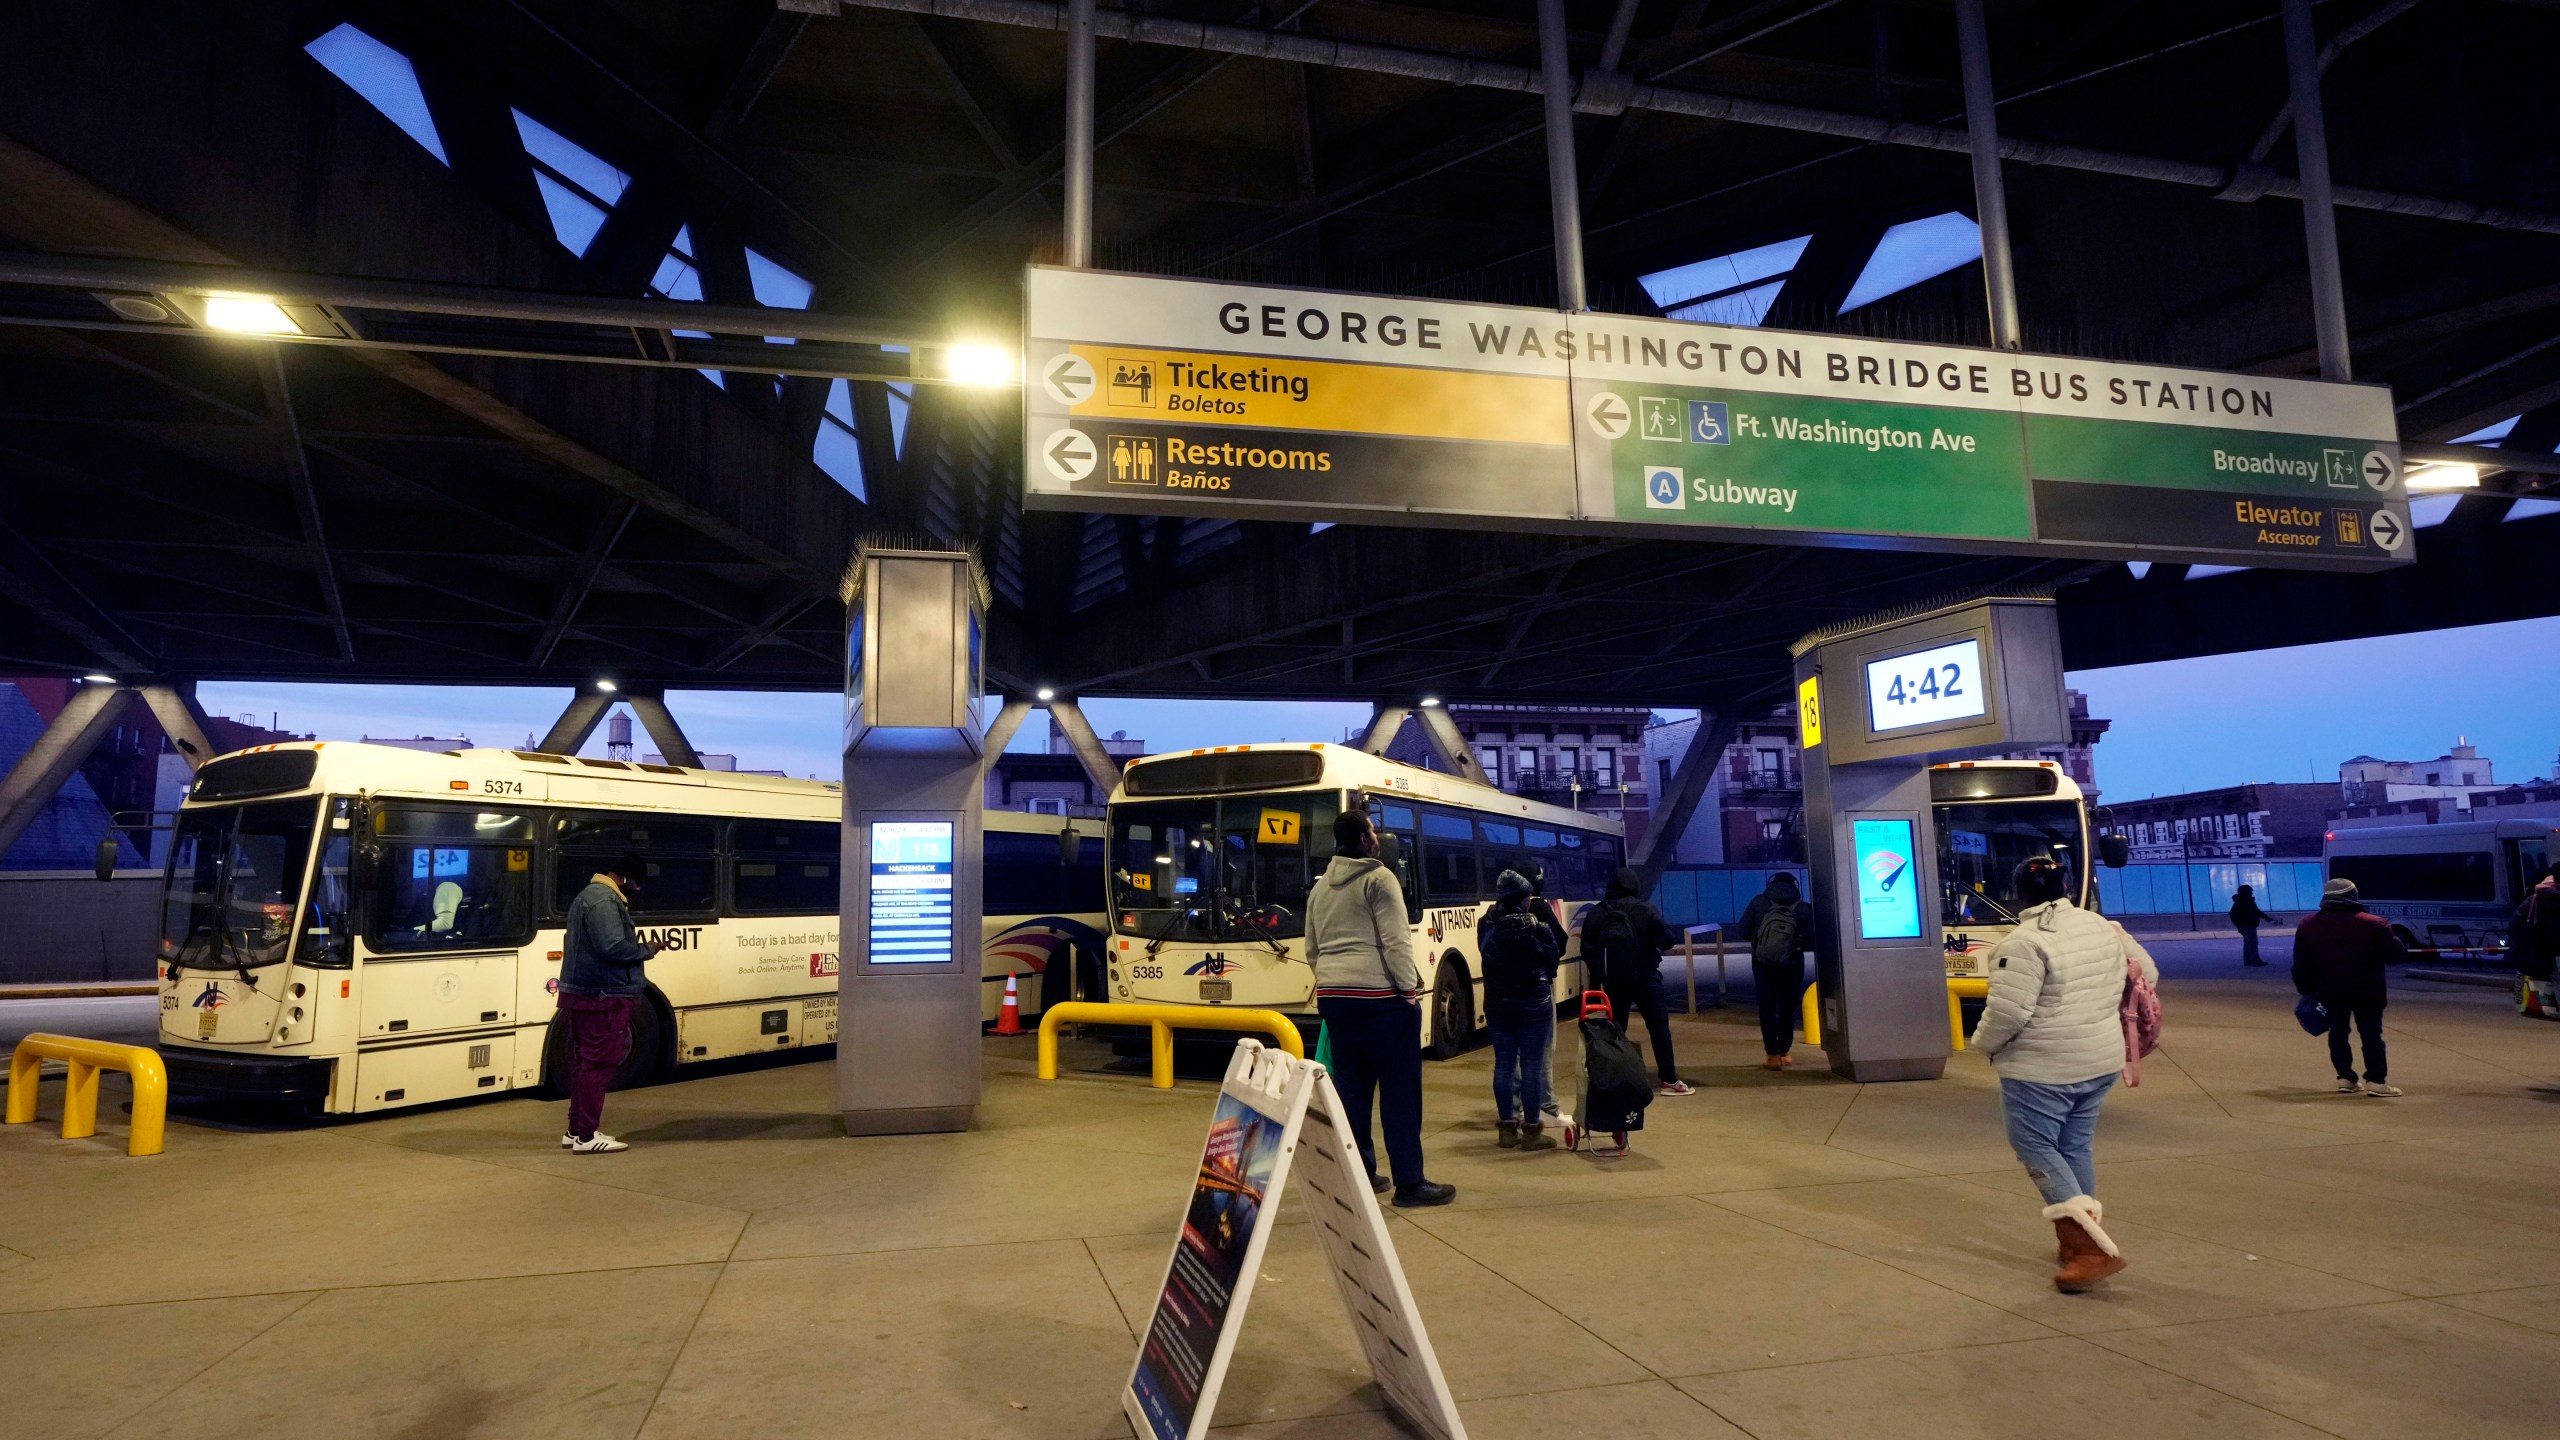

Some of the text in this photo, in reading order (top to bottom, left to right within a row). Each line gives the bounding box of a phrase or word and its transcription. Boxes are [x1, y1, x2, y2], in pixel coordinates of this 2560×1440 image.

[1218, 302, 2273, 418] GEORGE WASHINGTON BRIDGE BUS STATION
[1166, 361, 1309, 402] Ticketing
[1167, 394, 1246, 415] Boletos
[1736, 413, 1975, 452] Ft. Washington Ave
[1167, 437, 1331, 472] Restrooms
[2213, 449, 2319, 483] Broadway
[1166, 470, 1231, 490] Baños
[1657, 479, 1673, 498] A
[1692, 478, 1798, 513] Subway
[2235, 501, 2321, 527] Elevator
[2258, 529, 2320, 546] Ascensor
[1886, 663, 1963, 705] 4:42
[1803, 696, 1817, 730] 18
[484, 780, 523, 794] 5374
[2369, 906, 2442, 917] EXPRESS SERVICE
[1431, 908, 1475, 943] NJ TRANSIT
[636, 928, 702, 951] ANSIT
[736, 935, 767, 949] Today
[770, 934, 778, 946] is
[780, 936, 786, 945] a
[788, 933, 806, 945] bad
[809, 933, 825, 946] day
[759, 956, 790, 965] Same-Day
[824, 953, 839, 964] EN
[1205, 952, 1224, 975] NJ
[738, 966, 755, 974] Book
[1132, 966, 1163, 979] 5385
[162, 996, 179, 1011] 5374
[825, 1021, 835, 1030] US
